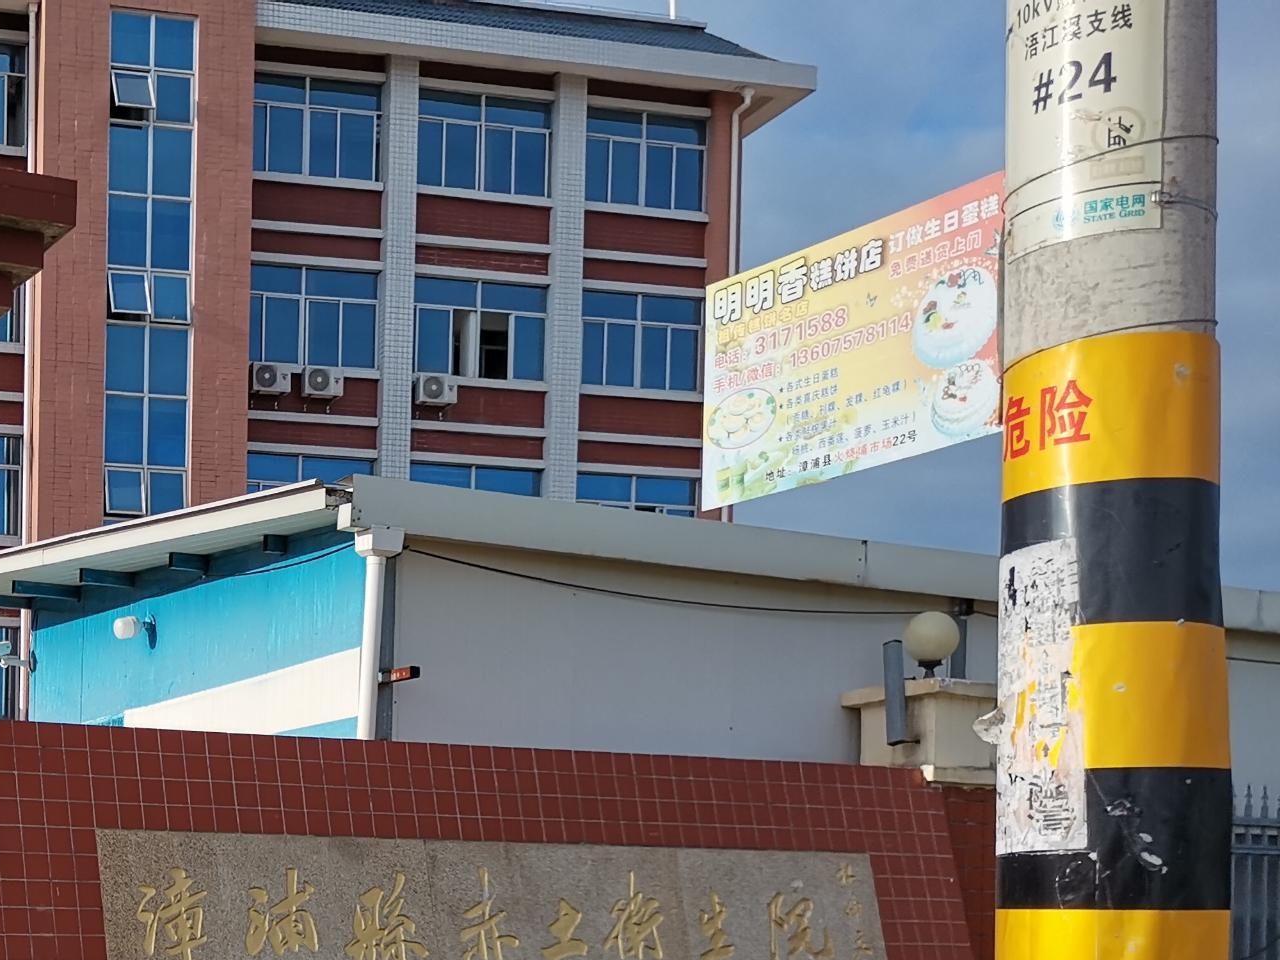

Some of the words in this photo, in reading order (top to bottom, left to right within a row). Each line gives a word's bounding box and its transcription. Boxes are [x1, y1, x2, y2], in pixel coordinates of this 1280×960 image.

[1032, 51, 1118, 115] #24
[888, 193, 1000, 255] 订做生日蛋糕
[1083, 193, 1146, 215] 国家电网
[1083, 211, 1116, 224] STATE
[1119, 208, 1146, 218] GRID
[713, 237, 884, 326] 明明香糕饼店
[1003, 379, 1094, 463] 危险
